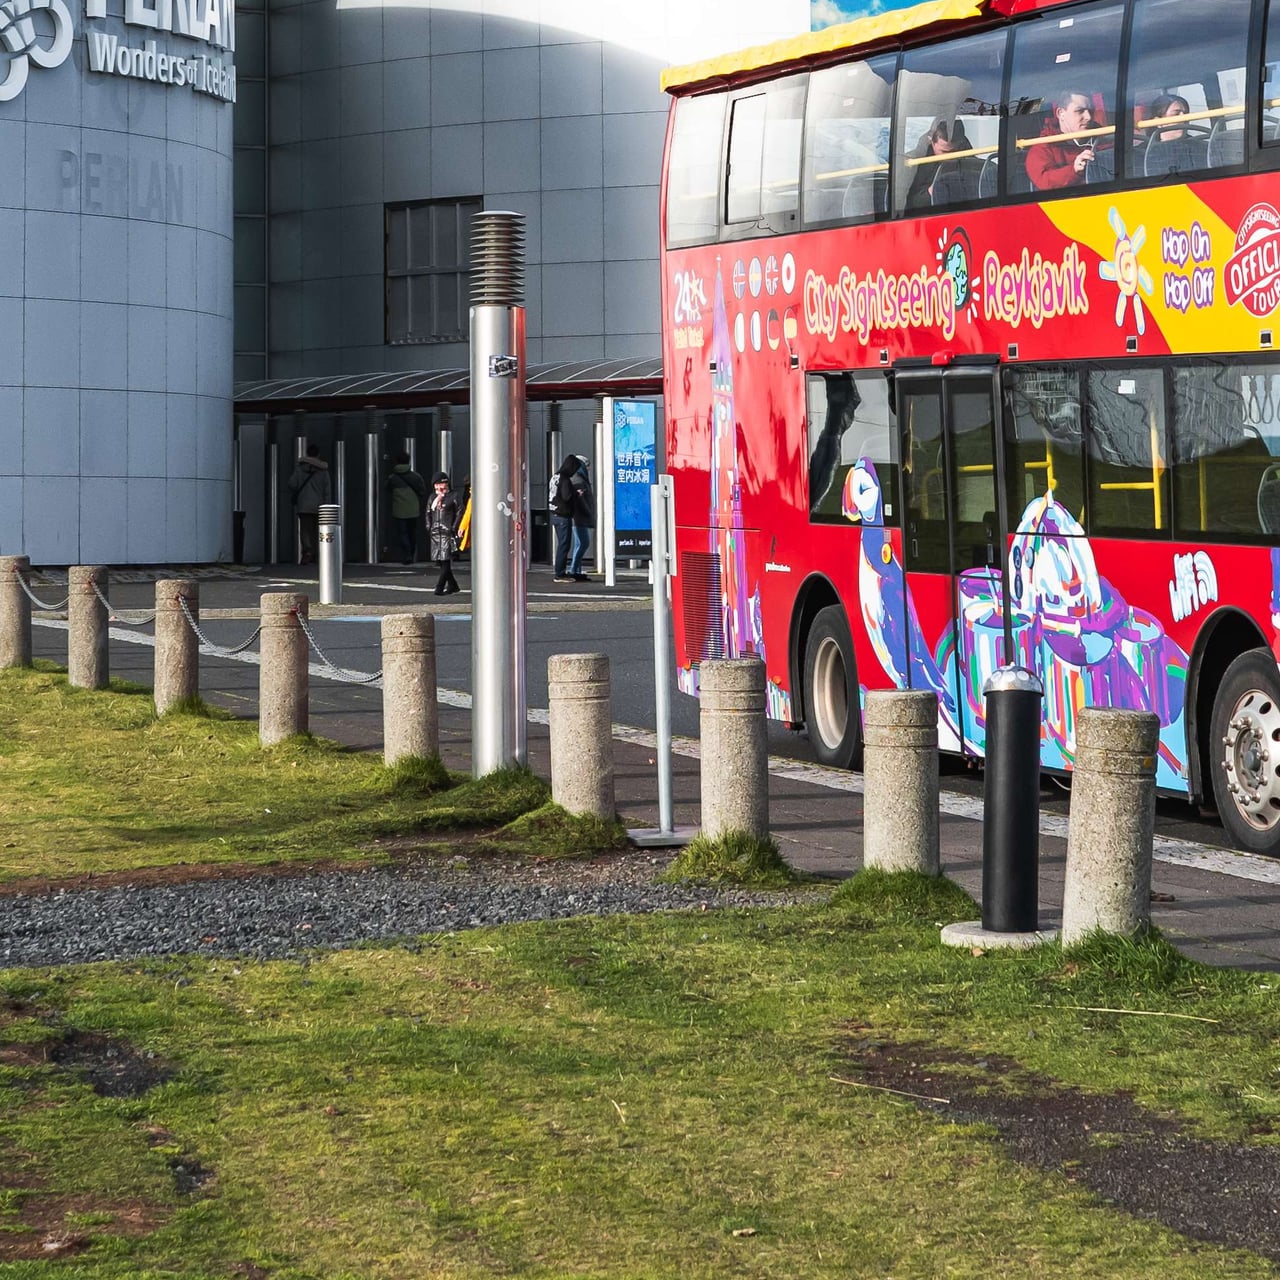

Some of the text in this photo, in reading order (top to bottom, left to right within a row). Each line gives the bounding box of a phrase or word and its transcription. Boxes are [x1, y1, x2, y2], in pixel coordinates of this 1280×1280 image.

[87, 32, 185, 86] Wonders
[186, 60, 197, 84] of
[1162, 221, 1210, 268] Hop On
[1237, 209, 1280, 246] CITYSIGHTSEEING
[983, 242, 1088, 328] Reykjavik
[1164, 267, 1214, 314] Hop Off
